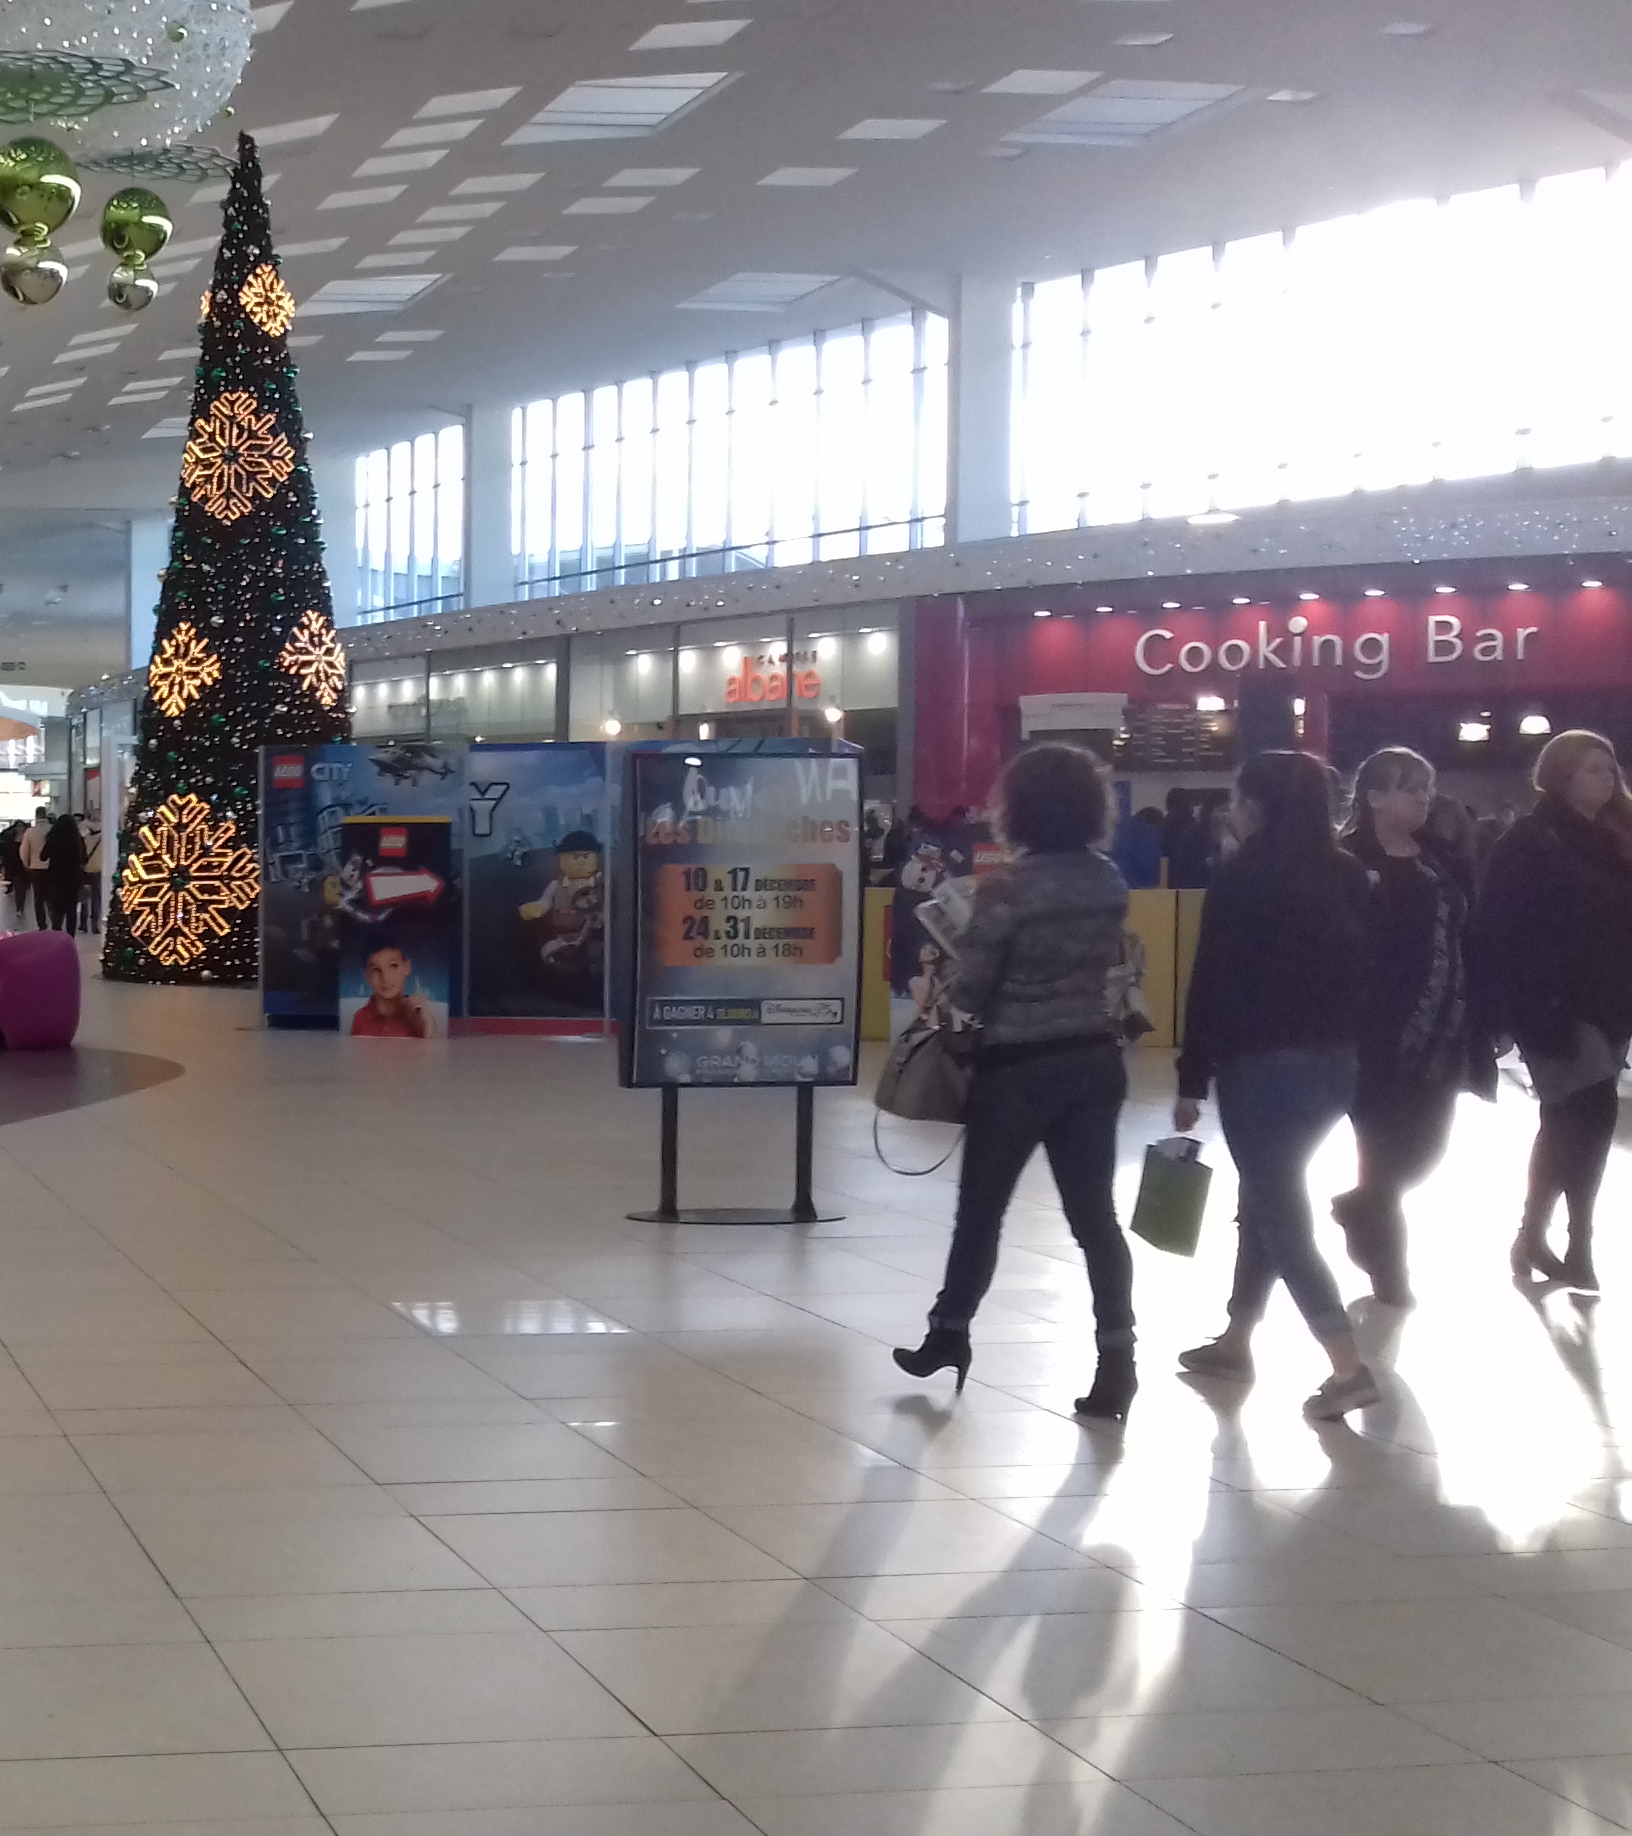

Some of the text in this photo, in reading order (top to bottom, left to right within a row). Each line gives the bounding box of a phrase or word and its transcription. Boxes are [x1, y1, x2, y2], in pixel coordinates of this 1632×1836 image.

[1134, 614, 1538, 680] Cooking Bar
[274, 764, 304, 779] LEGO
[682, 867, 708, 892] 10
[727, 867, 751, 892] 17
[694, 895, 715, 910] de
[722, 895, 752, 910] 10h
[773, 895, 803, 910] 19h
[682, 915, 709, 940] 24
[725, 915, 751, 940] 31
[693, 943, 715, 958] de
[720, 943, 751, 958] 10h
[756, 943, 766, 958] à
